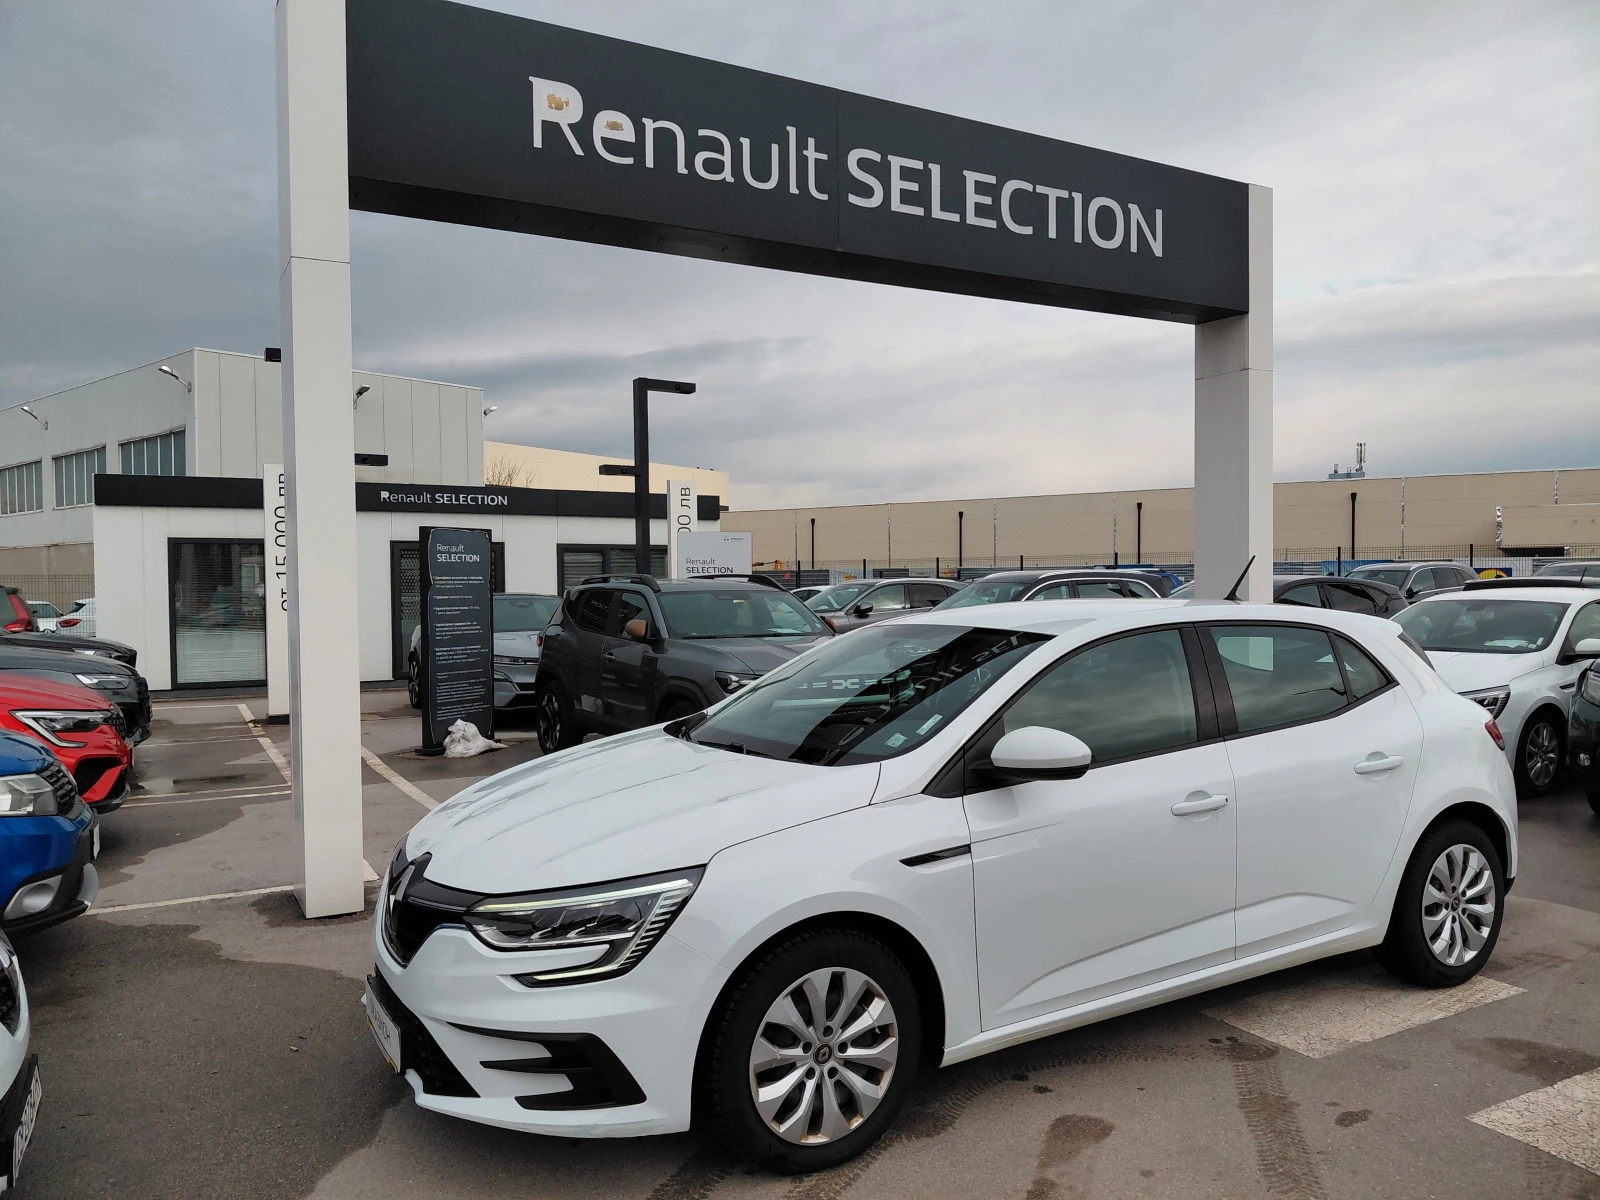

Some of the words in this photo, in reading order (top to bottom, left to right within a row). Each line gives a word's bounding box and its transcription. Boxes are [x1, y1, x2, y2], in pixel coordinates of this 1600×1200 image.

[528, 76, 829, 201] Renault
[847, 148, 1163, 258] SELECTION
[380, 490, 432, 504] Renault
[435, 493, 508, 506] SELECTION
[436, 543, 465, 552] Renault
[437, 553, 480, 562] SELECTION
[686, 557, 716, 566] Renault
[686, 566, 733, 574] SELECTION
